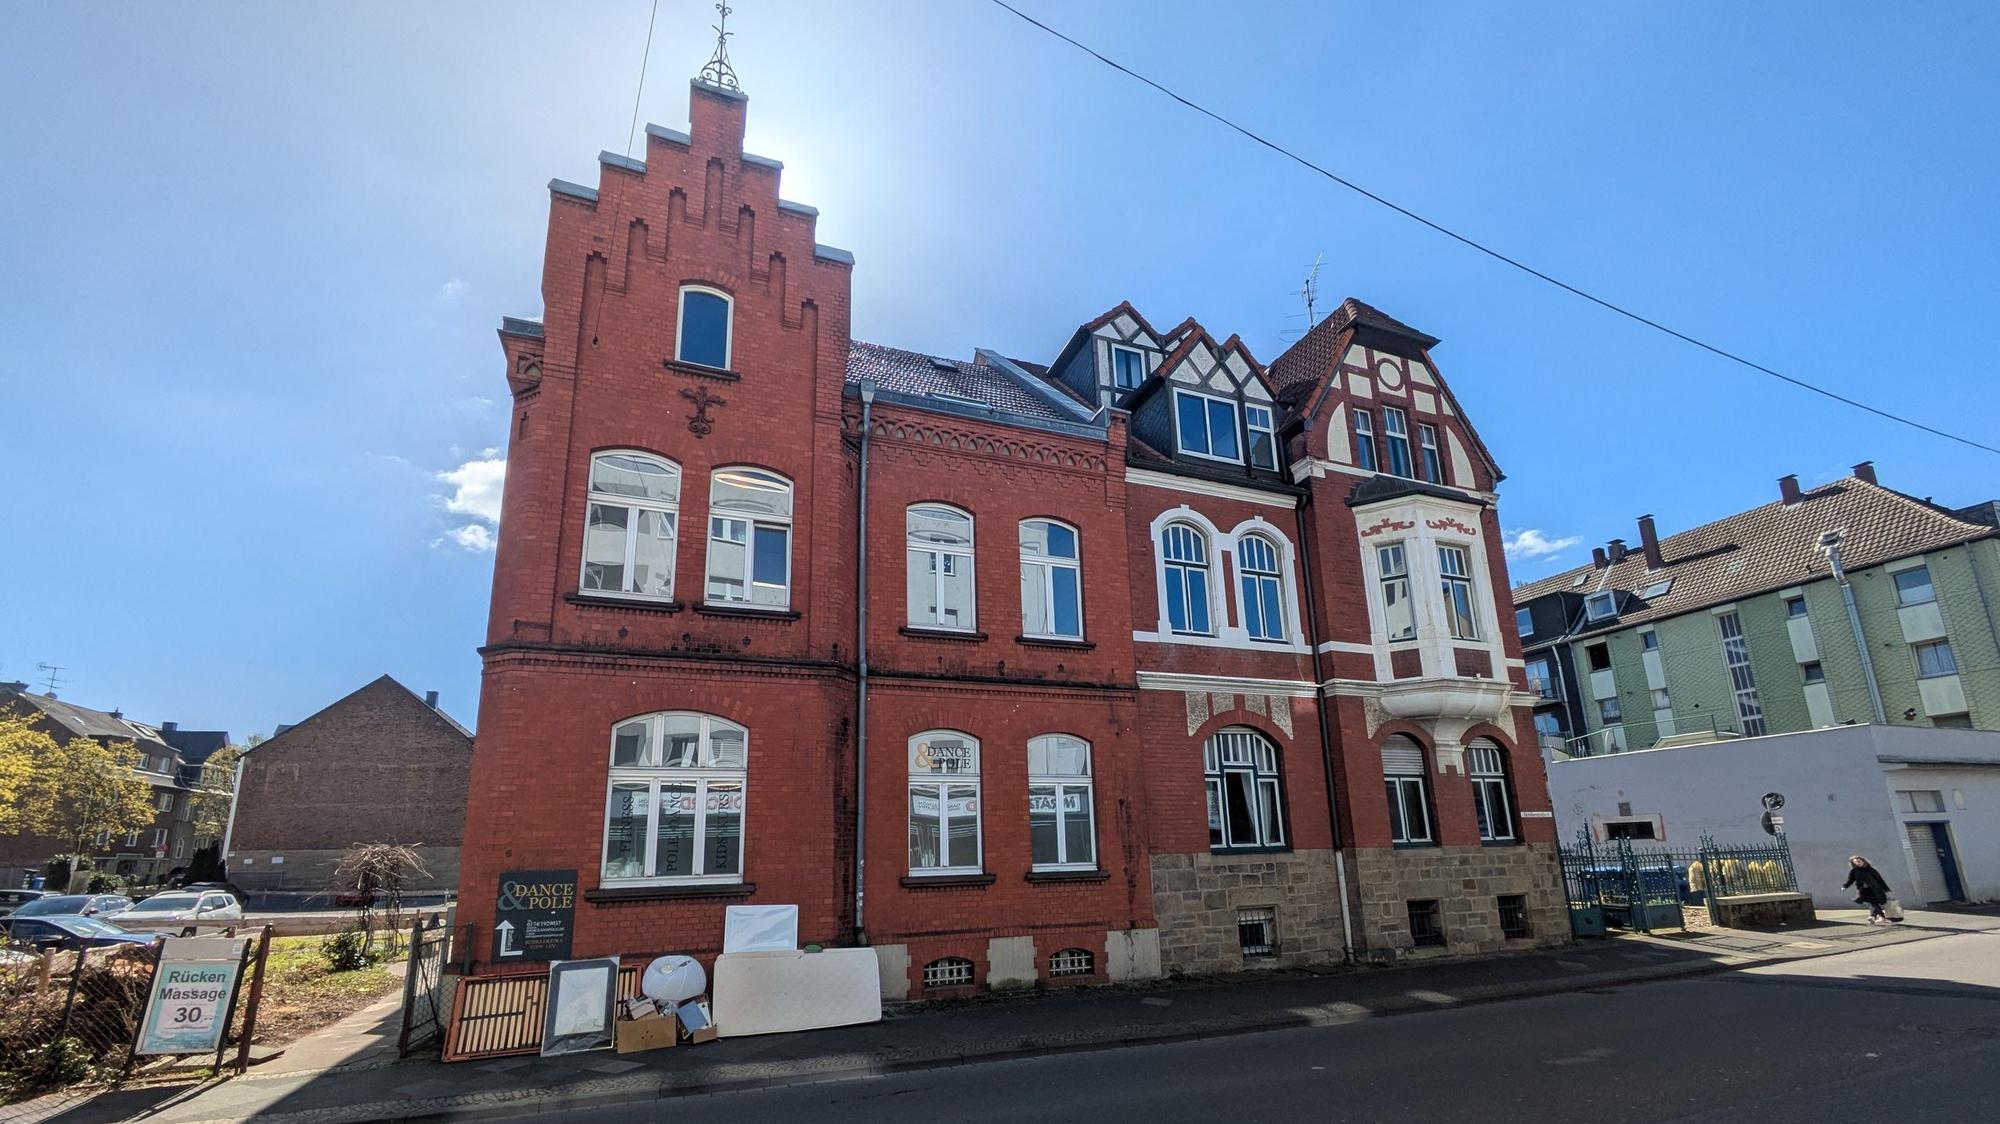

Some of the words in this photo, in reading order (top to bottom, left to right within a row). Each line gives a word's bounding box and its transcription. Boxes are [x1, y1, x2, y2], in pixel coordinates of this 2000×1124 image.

[927, 746, 971, 758] DANCE
[938, 758, 971, 769] POLE
[620, 795, 634, 853] FITNESS
[515, 883, 574, 897] DANCE
[528, 896, 573, 910] POLE
[168, 970, 226, 983] Rücken
[159, 987, 227, 1002] Massage
